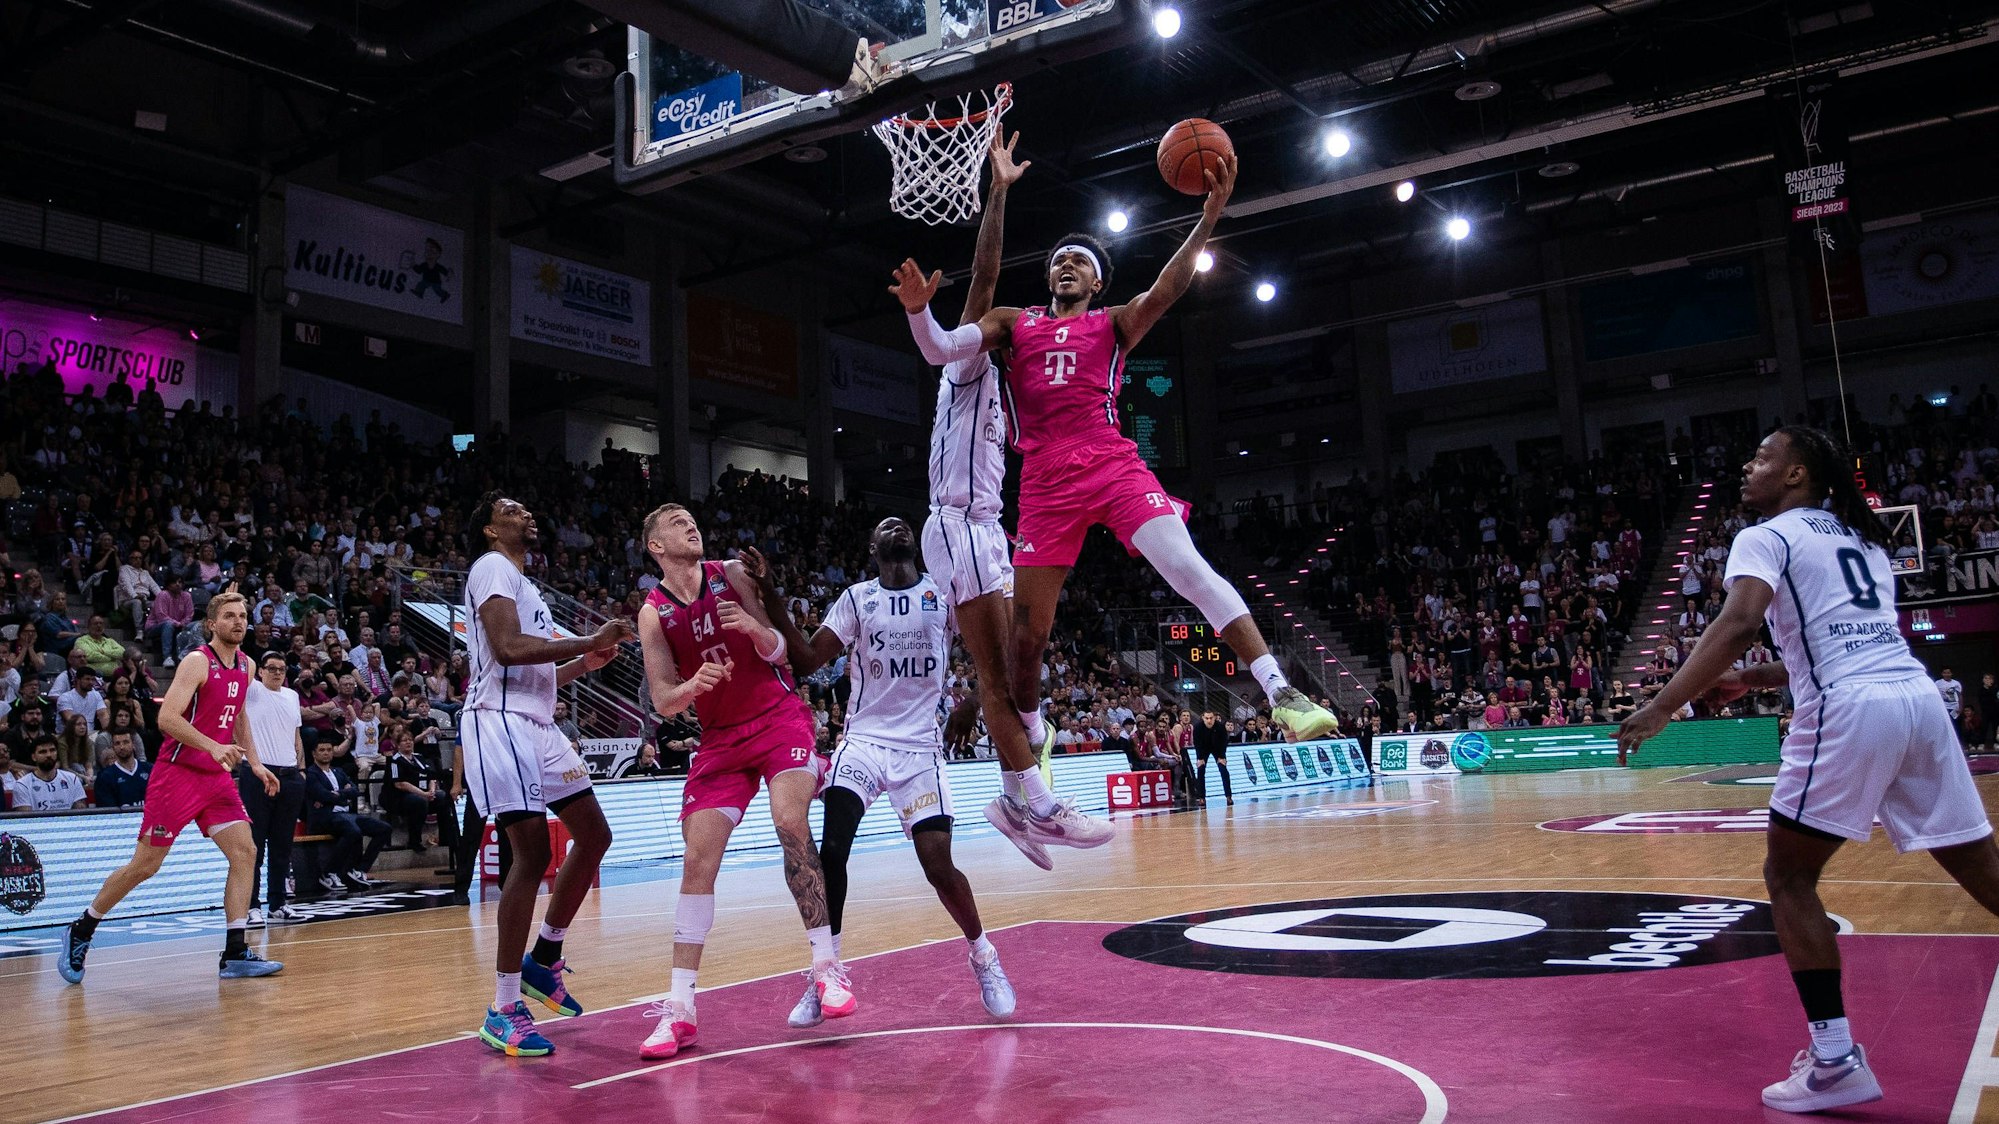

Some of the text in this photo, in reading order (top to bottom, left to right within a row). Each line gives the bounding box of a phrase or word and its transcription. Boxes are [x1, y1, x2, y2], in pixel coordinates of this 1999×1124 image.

[997, 0, 1043, 31] BBL
[680, 100, 736, 133] Credit
[1785, 161, 1846, 184] BASKETBALL
[1788, 173, 1845, 194] CHAMPIONS
[1800, 186, 1836, 205] LEAGUE
[1796, 201, 1844, 219] SIEGER 2023
[294, 240, 407, 293] Kulticus
[1706, 265, 1744, 281] dhpg
[564, 274, 632, 309] JAEGER
[304, 325, 319, 344] M
[524, 315, 536, 327] Ihr
[538, 318, 580, 335] Spezialist
[582, 327, 595, 339] für
[611, 334, 640, 350] BOSCH
[1055, 327, 1071, 344] 5
[49, 337, 185, 385] SPORTSCLUB
[1837, 547, 1880, 610] 0
[889, 595, 909, 616] 10
[691, 612, 715, 642] 54
[889, 629, 922, 641] koenig
[1171, 625, 1189, 639] 68
[1195, 625, 1204, 637] 4
[1829, 623, 1854, 636] MLP
[889, 641, 933, 651] solutions
[1190, 646, 1220, 662] 8:15
[890, 657, 937, 678] MLP
[1226, 661, 1235, 676] 0
[227, 681, 240, 698] 19
[1381, 760, 1405, 769] Bank
[1421, 753, 1447, 762] BASKETS
[46, 782, 56, 793] 15
[0, 873, 42, 894] ASKETS
[1542, 903, 1756, 967] bechtle
